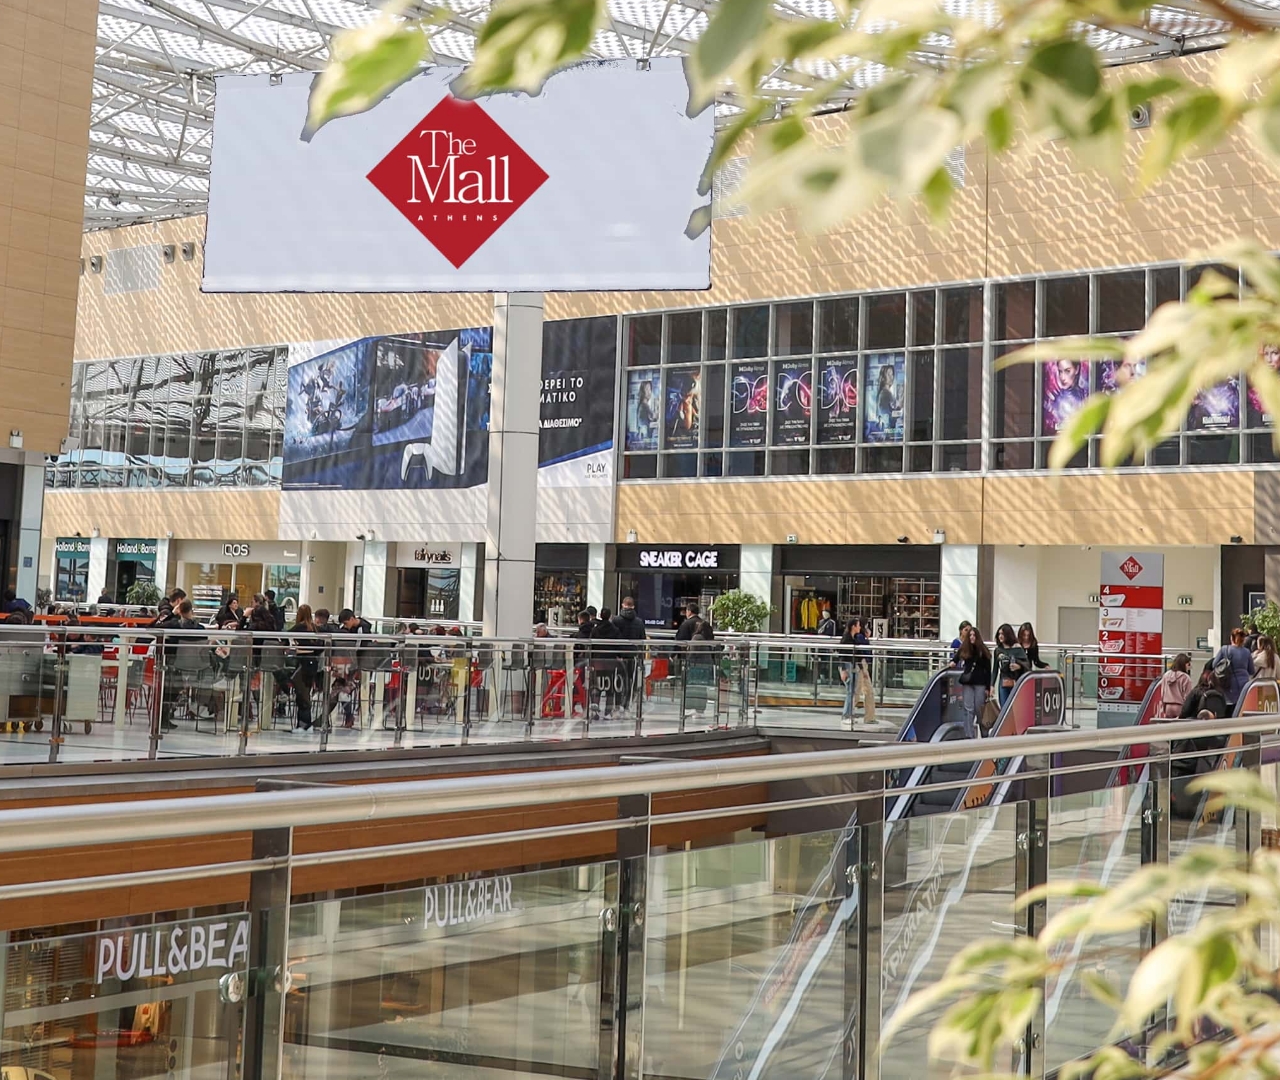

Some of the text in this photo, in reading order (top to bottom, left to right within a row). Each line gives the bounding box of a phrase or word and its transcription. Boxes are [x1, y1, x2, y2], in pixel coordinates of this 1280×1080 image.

[420, 130, 477, 168] The
[406, 154, 513, 204] Mall
[417, 214, 500, 222] ATHENS
[587, 462, 607, 473] PLAY
[221, 543, 250, 557] IQOS
[639, 550, 719, 568] SNEAKER CAGE
[1103, 585, 1110, 595] 4
[1103, 608, 1109, 617] 3
[1102, 631, 1109, 640] 2
[423, 876, 513, 930] PULL&BEAR
[96, 920, 249, 985] PULL&BEA
